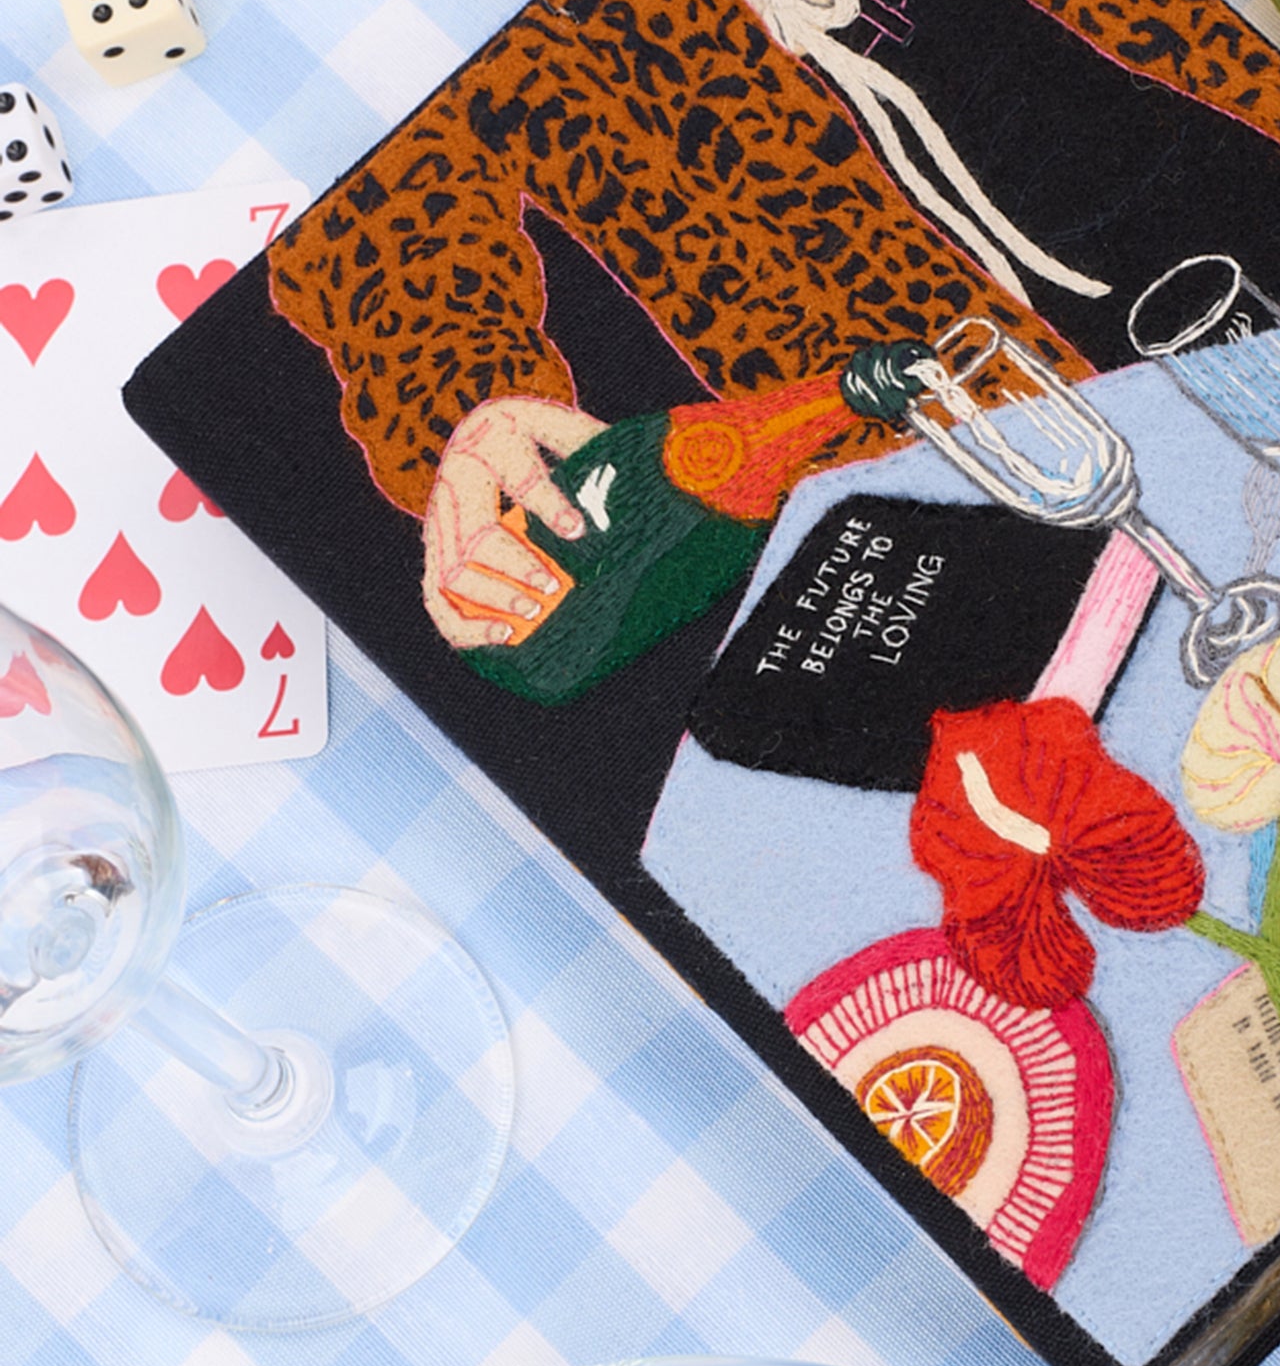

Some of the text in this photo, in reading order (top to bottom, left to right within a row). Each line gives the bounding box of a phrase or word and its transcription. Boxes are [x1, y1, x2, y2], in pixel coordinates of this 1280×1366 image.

[249, 203, 290, 246] 7
[756, 517, 872, 675] THE FUTURE
[801, 535, 893, 674] BELONGS TO
[853, 593, 893, 639] THE
[870, 554, 946, 665] LOVING
[257, 673, 300, 738] 7
